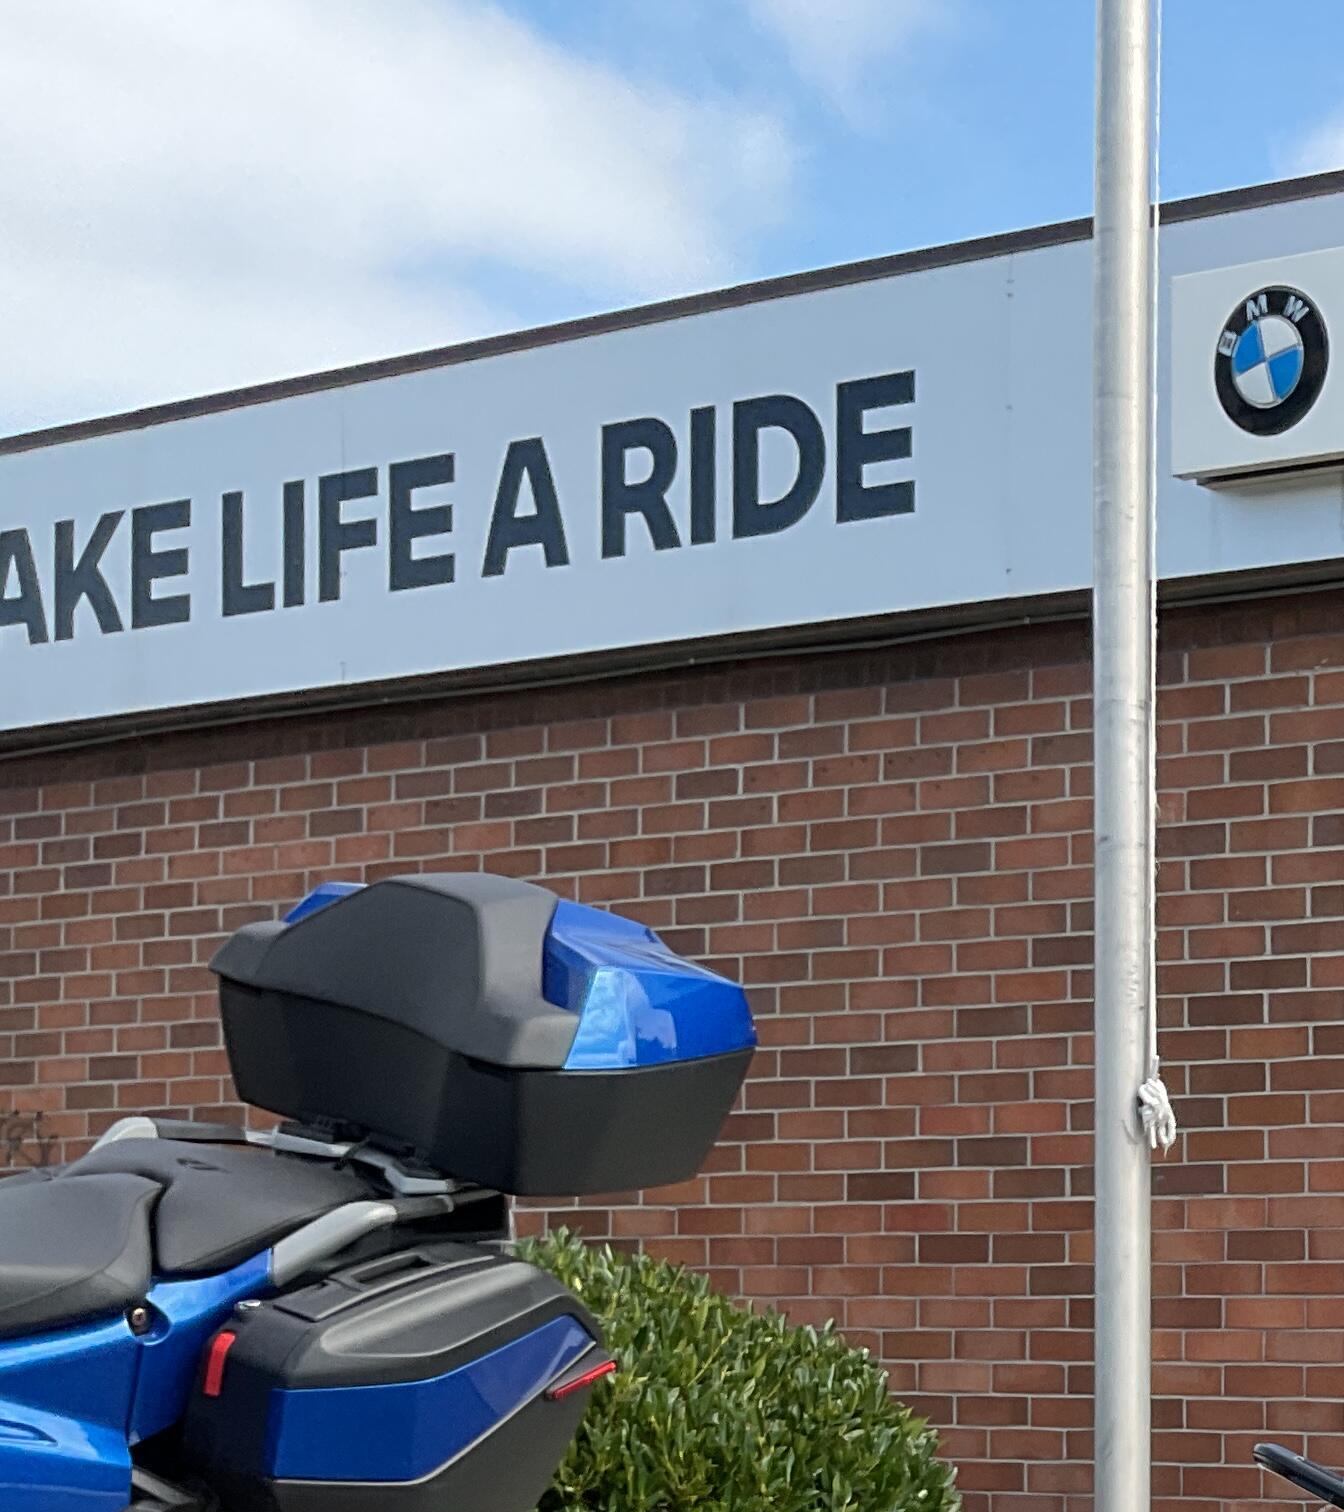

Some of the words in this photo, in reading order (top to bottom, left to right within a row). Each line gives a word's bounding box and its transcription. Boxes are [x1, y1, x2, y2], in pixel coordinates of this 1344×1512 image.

[1218, 293, 1309, 357] BMW
[222, 452, 456, 617] LIFE
[481, 436, 570, 578] A
[601, 369, 916, 560] RIDE
